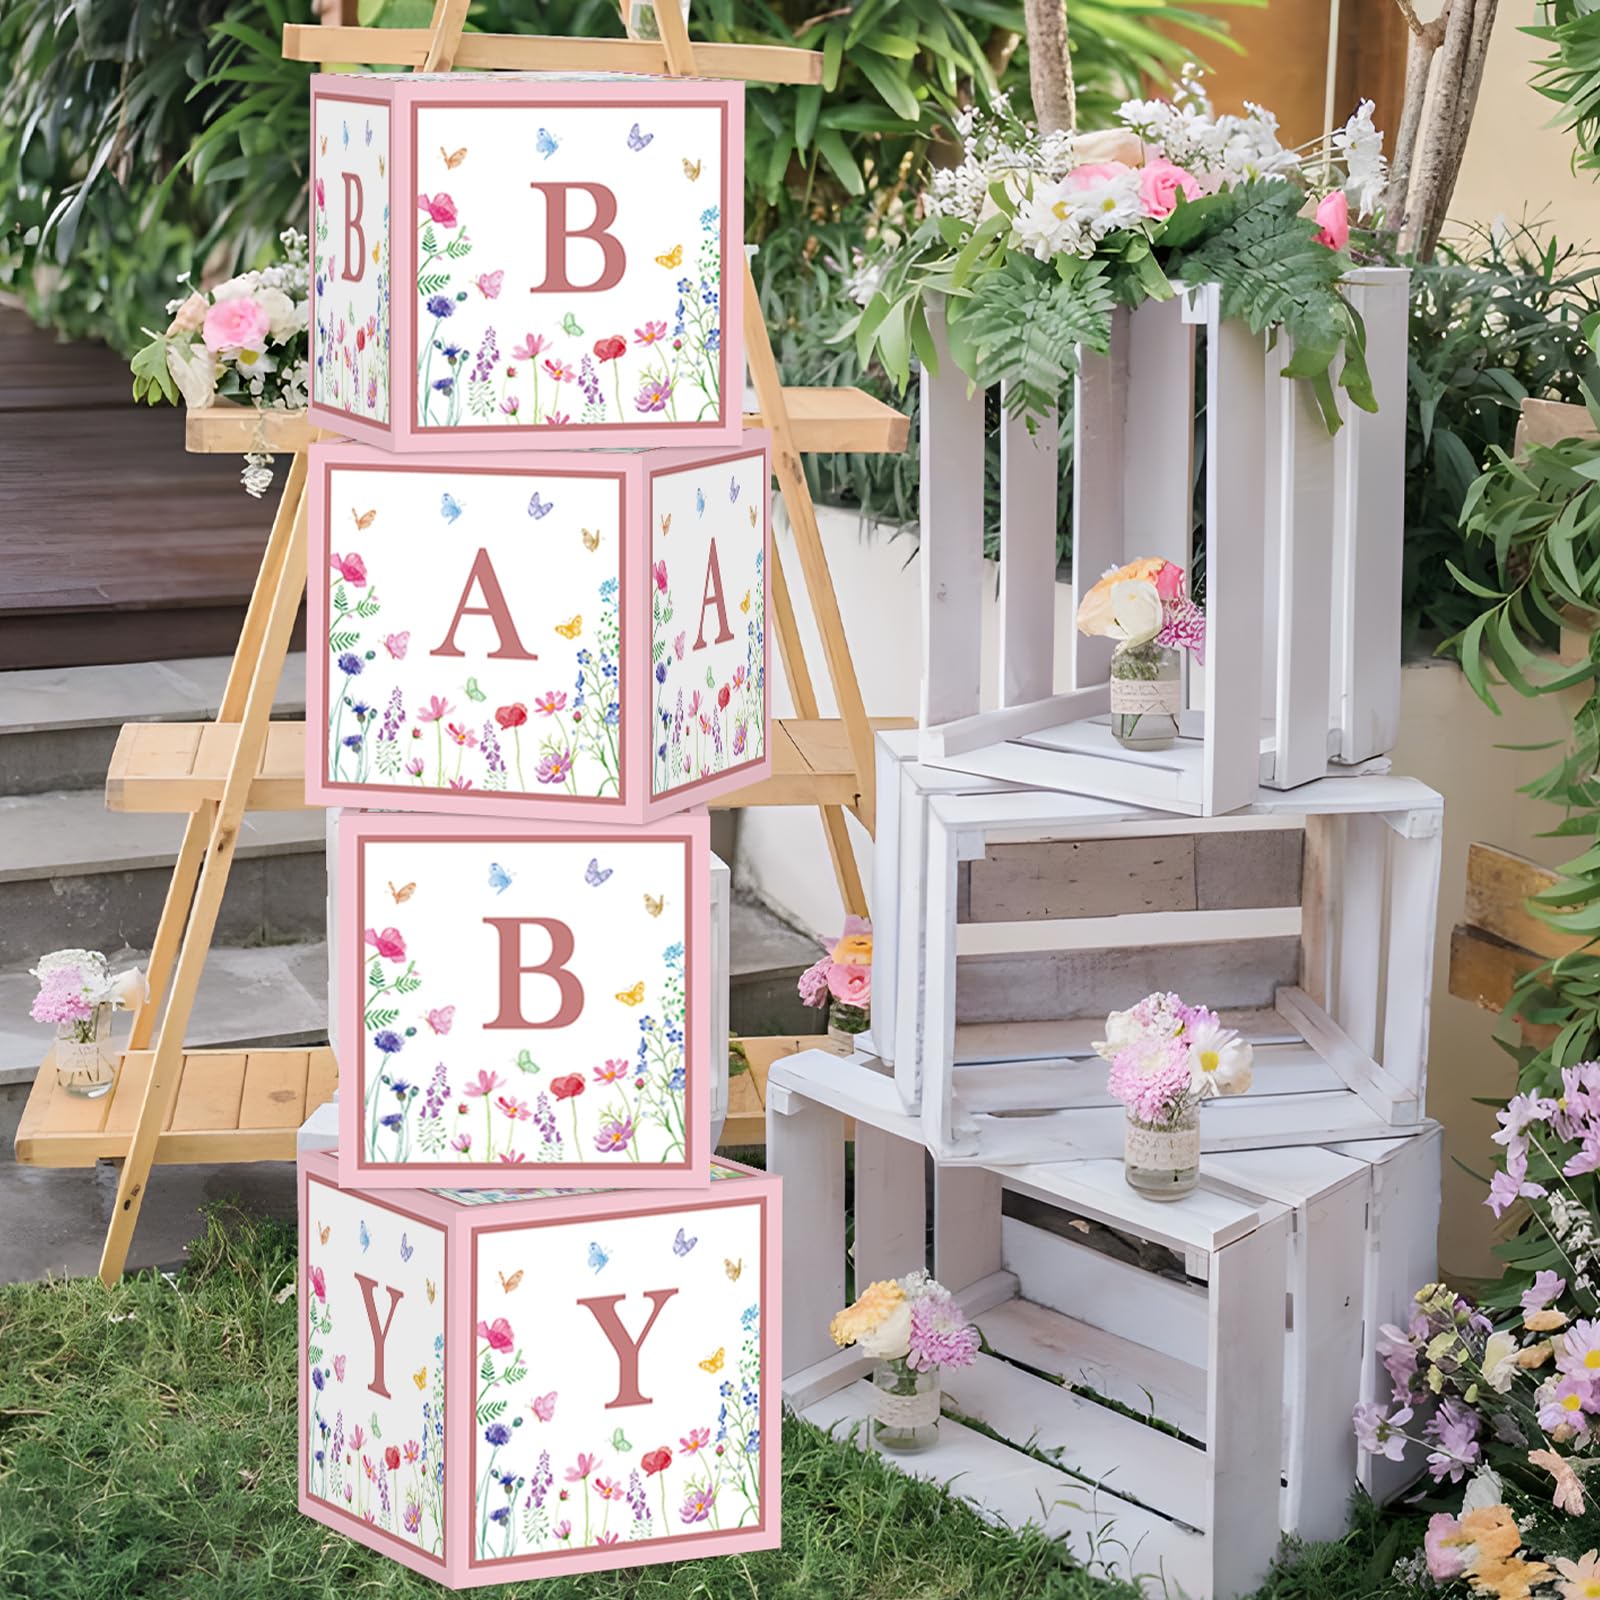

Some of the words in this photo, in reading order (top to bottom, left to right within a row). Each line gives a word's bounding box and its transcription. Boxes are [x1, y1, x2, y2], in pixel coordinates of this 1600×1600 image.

[341, 171, 365, 284] B
[530, 182, 627, 293] B
[430, 548, 538, 660] A
[692, 537, 734, 651] A
[482, 917, 585, 1030] B
[353, 1271, 404, 1400] Y
[576, 1288, 679, 1409] Y
